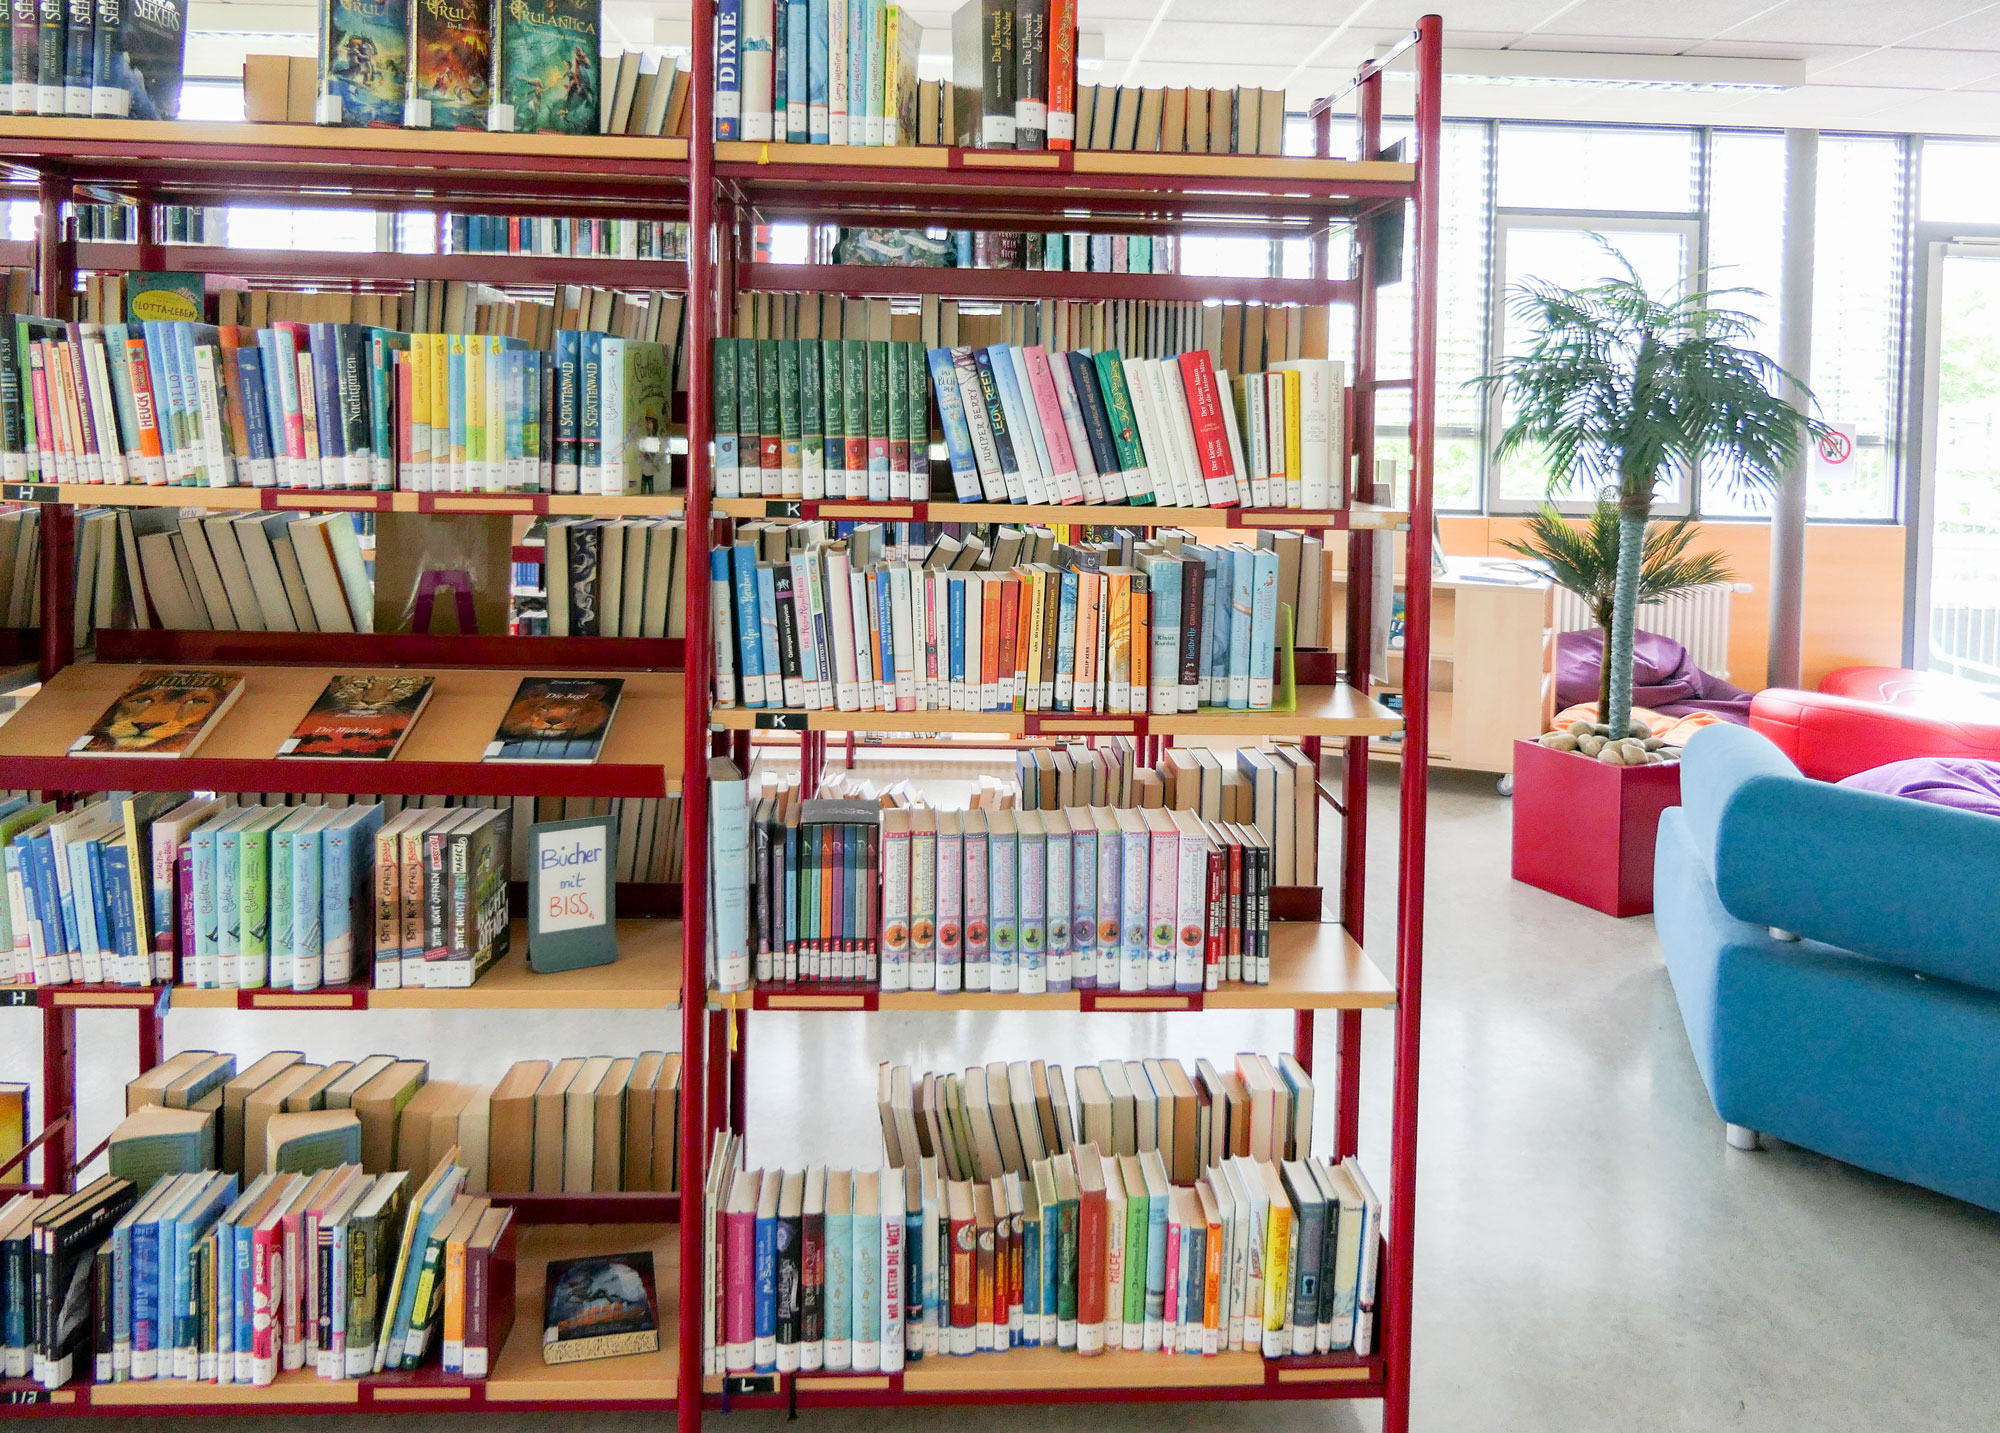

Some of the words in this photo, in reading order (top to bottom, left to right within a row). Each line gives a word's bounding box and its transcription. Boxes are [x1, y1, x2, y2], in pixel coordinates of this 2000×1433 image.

[991, 10, 1001, 46] Uhrwerk
[1003, 12, 1011, 35] Nacht
[1022, 13, 1032, 48] Uhrwerk
[1034, 14, 1042, 37] Nacht
[720, 12, 736, 83] DIXIE
[992, 48, 1001, 62] Das
[1022, 51, 1031, 65] Das
[1034, 41, 1042, 52] der
[834, 52, 842, 80] Valentine
[853, 53, 861, 82] Valentine
[871, 53, 879, 82] Valentine
[834, 84, 845, 101] Sunny
[853, 84, 863, 102] Sunny
[871, 84, 881, 102] Sunny
[138, 301, 196, 318] LOTTA-LEBEN
[112, 331, 121, 358] EULEN
[980, 369, 996, 400] REED
[1192, 368, 1201, 386] Mann
[1201, 374, 1210, 392] kleine
[168, 375, 184, 406] MILO
[184, 375, 198, 407] MILO
[346, 357, 362, 423] Nachtgarten
[560, 362, 574, 426] SCHATTENWALD
[585, 362, 599, 426] SCHATTENWALD
[1196, 387, 1205, 404] kleine
[1204, 393, 1212, 402] die
[136, 395, 153, 427] HEUCK
[967, 388, 982, 419] BERRY
[1207, 403, 1215, 415] und
[989, 404, 1005, 435] LEON
[976, 423, 993, 463] JUNIPER
[1207, 441, 1215, 458] kleine
[1215, 440, 1223, 457] Mann
[19, 486, 34, 499] H
[787, 502, 801, 516] K
[738, 570, 755, 604] Räuber
[783, 604, 791, 627] Labyrinth
[546, 692, 563, 700] Die
[563, 692, 589, 701] Jagd
[314, 726, 332, 734] Die
[333, 726, 383, 735] Wahrheit
[774, 716, 786, 728] K
[453, 844, 464, 872] MAGIC!
[542, 842, 602, 870] Bücher
[379, 865, 393, 896] ÖFFNEN
[405, 864, 418, 894] ÖFFNEN
[431, 872, 441, 903] ÖFFNEN
[453, 874, 467, 899] ÖFFNEN
[560, 872, 586, 889] mit
[380, 898, 391, 920] NICHT
[406, 898, 417, 918] NICHT
[432, 906, 442, 925] NICHT
[455, 901, 465, 926] NICHT
[380, 922, 391, 944] BITTE
[406, 921, 416, 942] BITTE
[431, 927, 442, 947] BITTE
[455, 928, 465, 949] BITTE
[13, 991, 26, 1005] H
[887, 1223, 900, 1246] WELT
[238, 1240, 249, 1269] CLUB
[805, 1240, 815, 1268] QUEST
[888, 1250, 899, 1265] DIE
[1274, 1246, 1286, 1267] STADT
[805, 1269, 816, 1306] ROMAN
[887, 1268, 899, 1299] RETTEN
[888, 1303, 898, 1319] WIR
[741, 1379, 755, 1392] L
